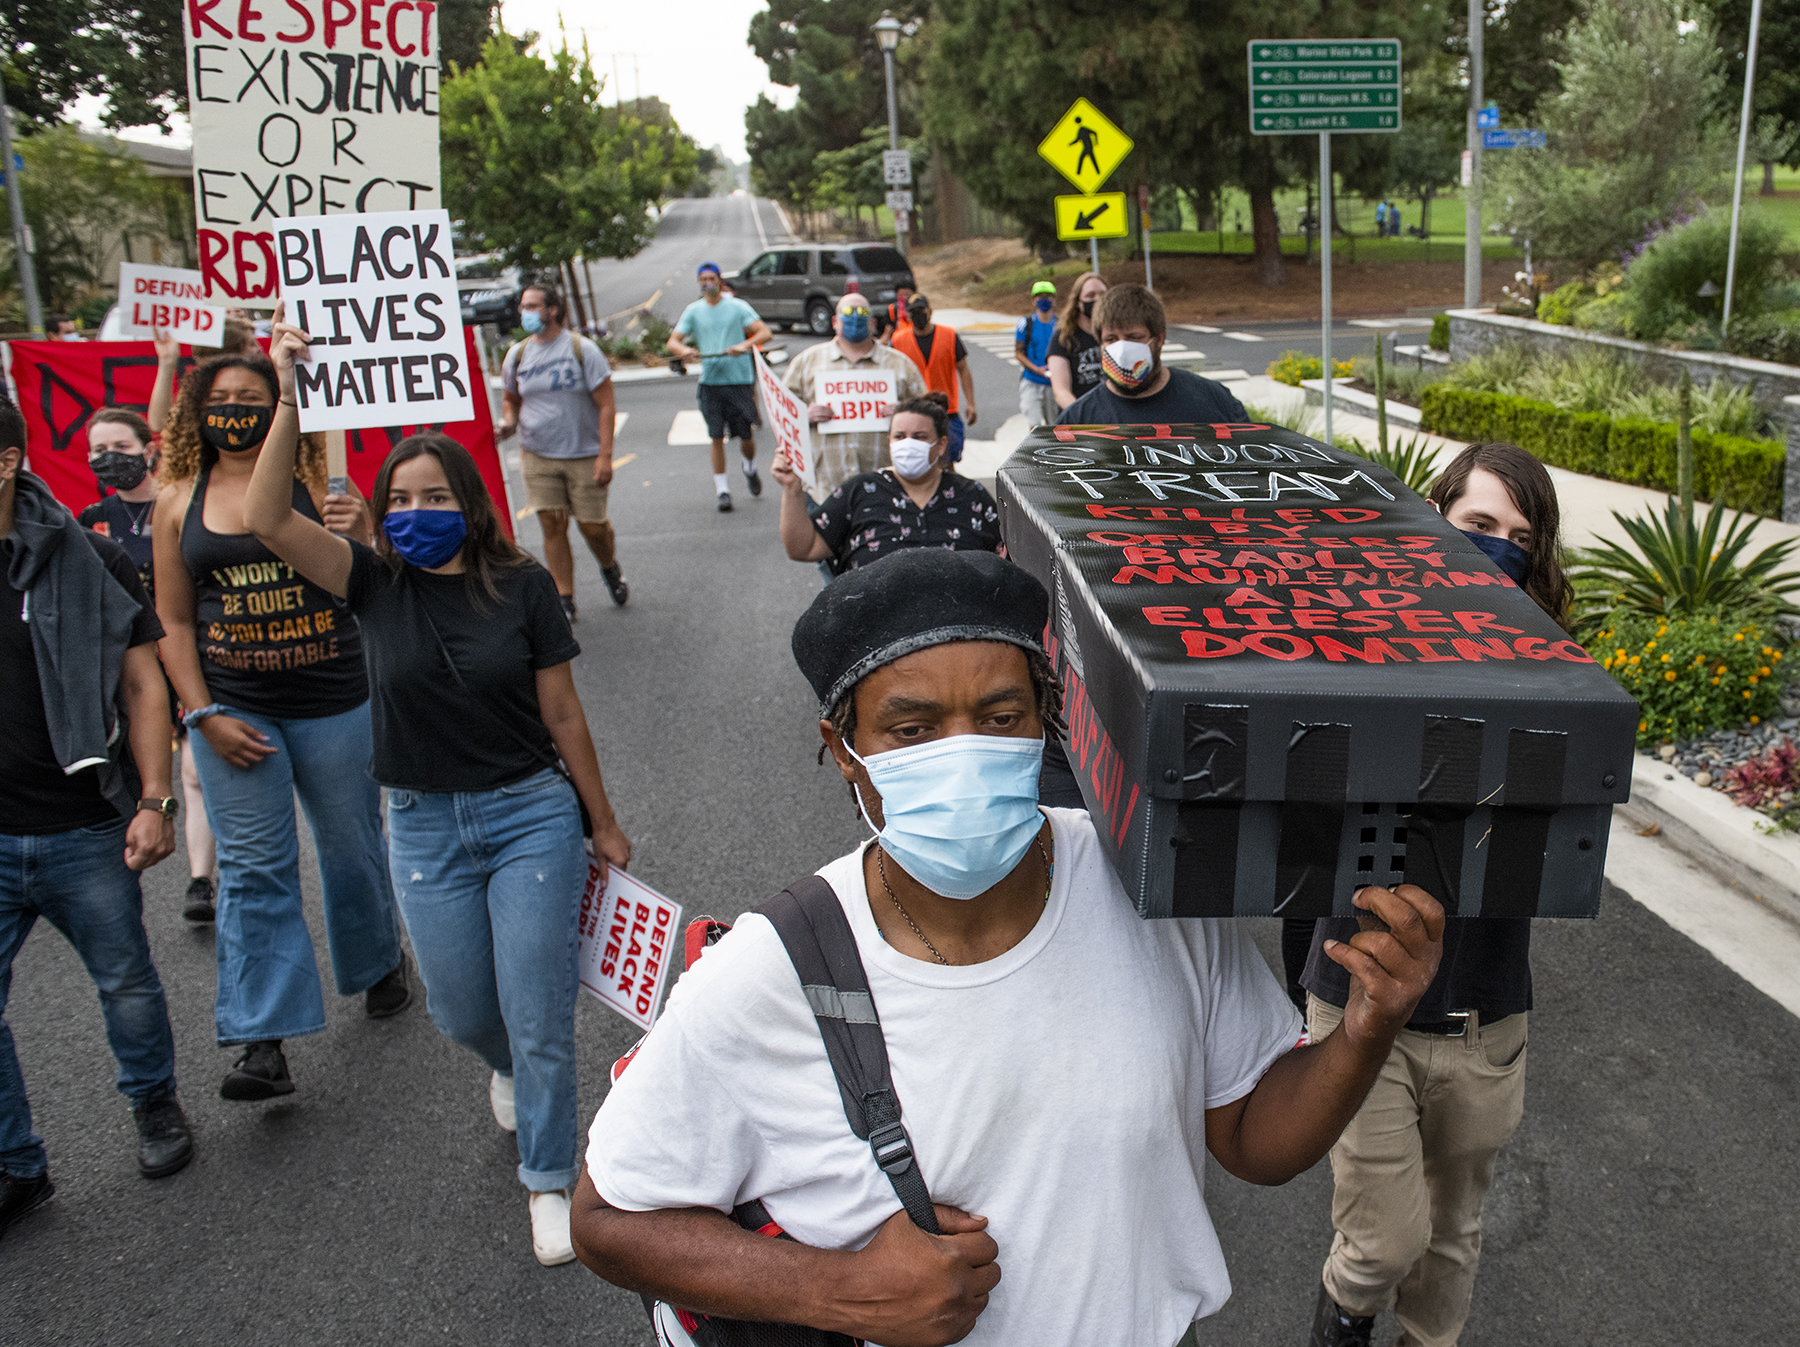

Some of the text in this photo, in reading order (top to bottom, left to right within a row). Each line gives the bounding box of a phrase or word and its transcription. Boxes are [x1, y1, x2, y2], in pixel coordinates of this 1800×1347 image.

[187, 0, 436, 57] RESPECT
[194, 45, 439, 116] EXISTENCE
[258, 113, 365, 167] OR
[198, 168, 433, 224] EXPECT
[198, 229, 280, 299] RES
[279, 224, 450, 286] BLACK
[134, 277, 203, 301] DEFUN
[133, 303, 213, 331] LBPD
[297, 292, 446, 346] LIVES
[295, 353, 467, 409] MATTER
[550, 369, 576, 392] 23
[825, 381, 888, 395] DEFUND
[1053, 423, 1272, 442] RIP
[1032, 443, 1340, 466] SINUON
[1046, 469, 1396, 501] PREAM
[1086, 504, 1382, 524] KILLED
[1210, 522, 1310, 538] BY
[1086, 531, 1441, 549] OFFICERS
[1122, 546, 1446, 570] BRADLEY
[221, 585, 304, 615] BE QUIET
[1225, 587, 1422, 609] AND
[224, 623, 263, 643] YOU
[268, 615, 311, 641] CAN
[314, 610, 335, 634] BE
[1141, 606, 1525, 634] ELIESER
[206, 637, 339, 671] COMFORTABLE
[1181, 630, 1597, 663] DOMINGO
[587, 913, 598, 938] THE
[601, 896, 630, 979] LIVES
[617, 902, 650, 998] BLACK
[636, 905, 671, 1016] DEFEND
